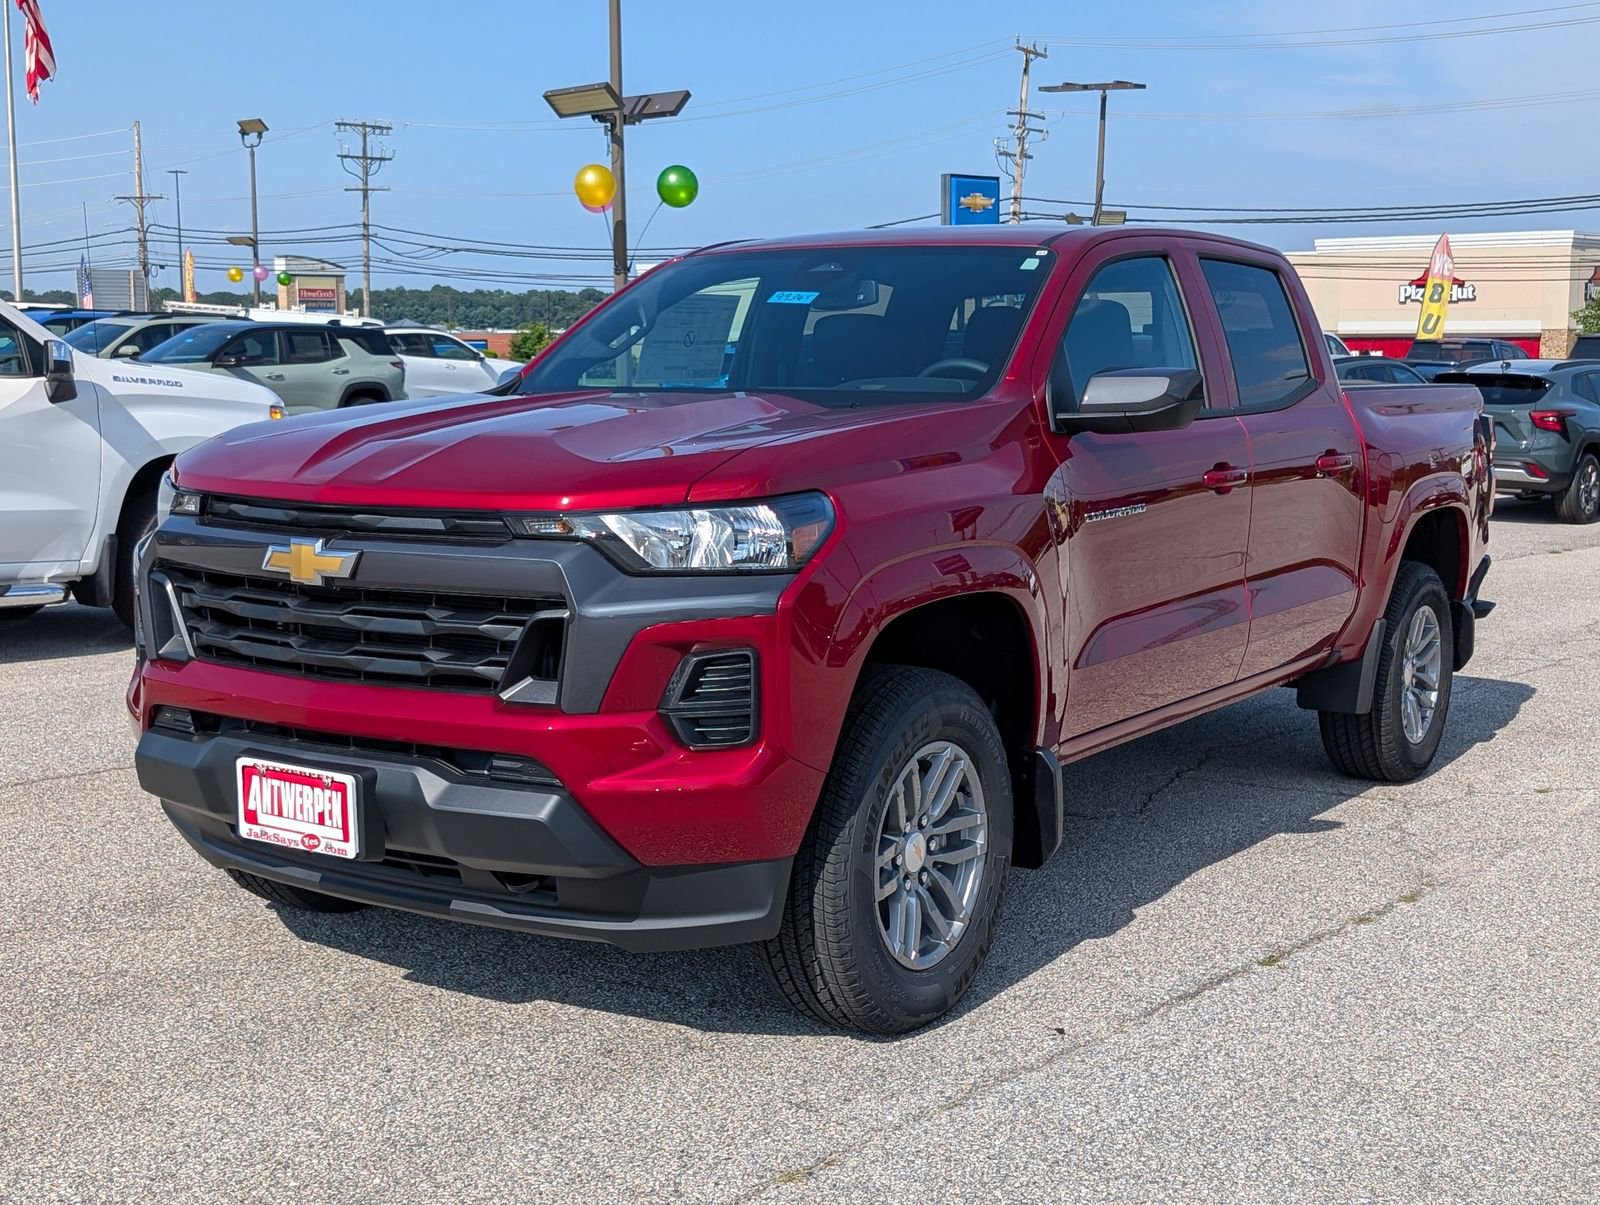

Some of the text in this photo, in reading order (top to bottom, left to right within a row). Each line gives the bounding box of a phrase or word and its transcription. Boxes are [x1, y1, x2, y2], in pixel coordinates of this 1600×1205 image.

[300, 289, 335, 298] HomeGoods
[1448, 283, 1476, 303] Hut
[112, 375, 183, 388] SILVERADO
[1084, 503, 1148, 523] COLORADO
[248, 774, 343, 829] ANTWERPEN
